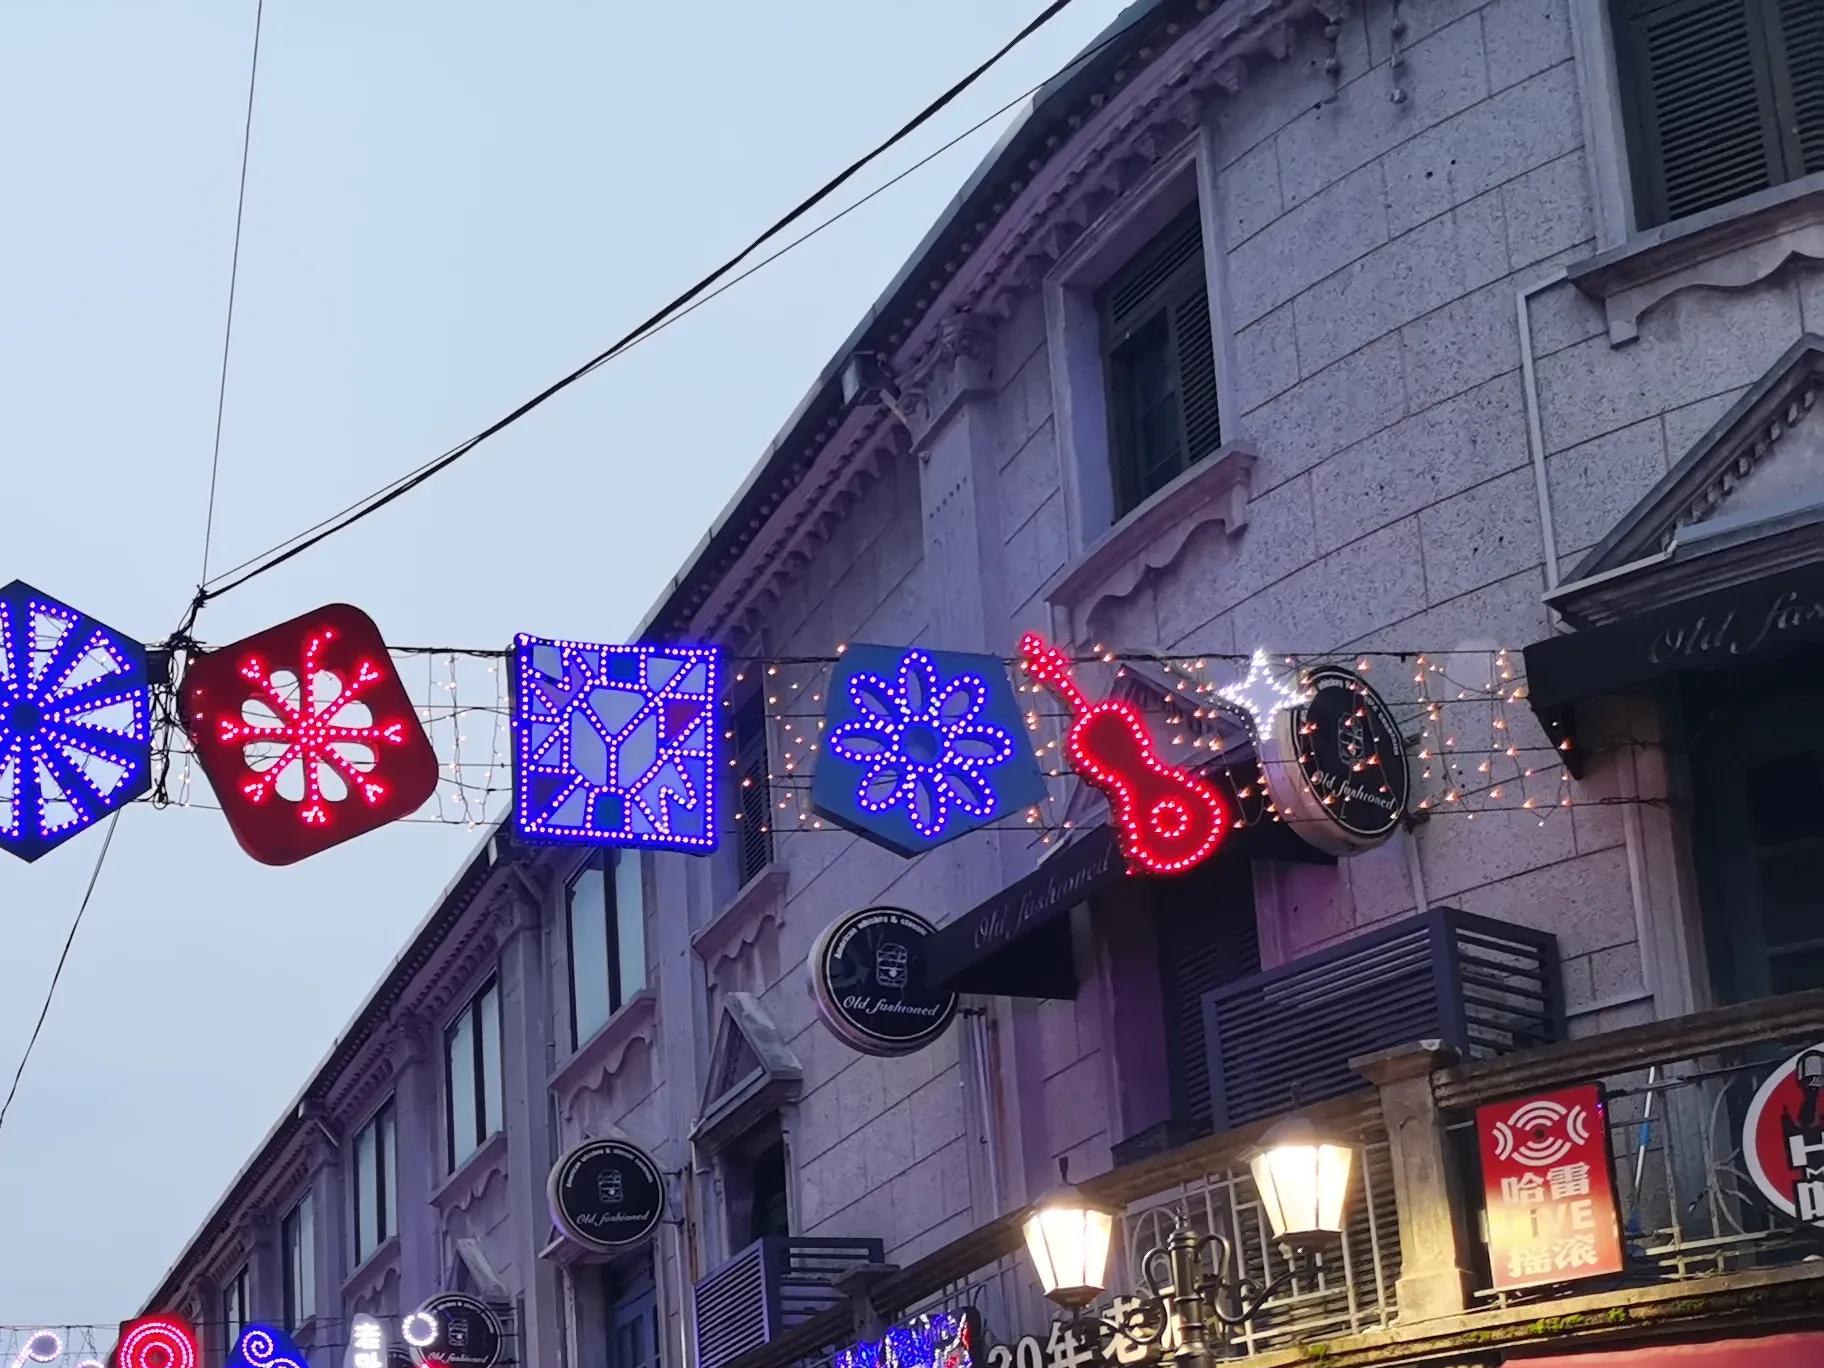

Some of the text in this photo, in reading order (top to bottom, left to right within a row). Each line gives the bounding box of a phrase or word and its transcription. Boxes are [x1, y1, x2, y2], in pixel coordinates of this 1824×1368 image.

[842, 994, 941, 1017] Old fashioned
[1500, 1161, 1590, 1205] 哈雷
